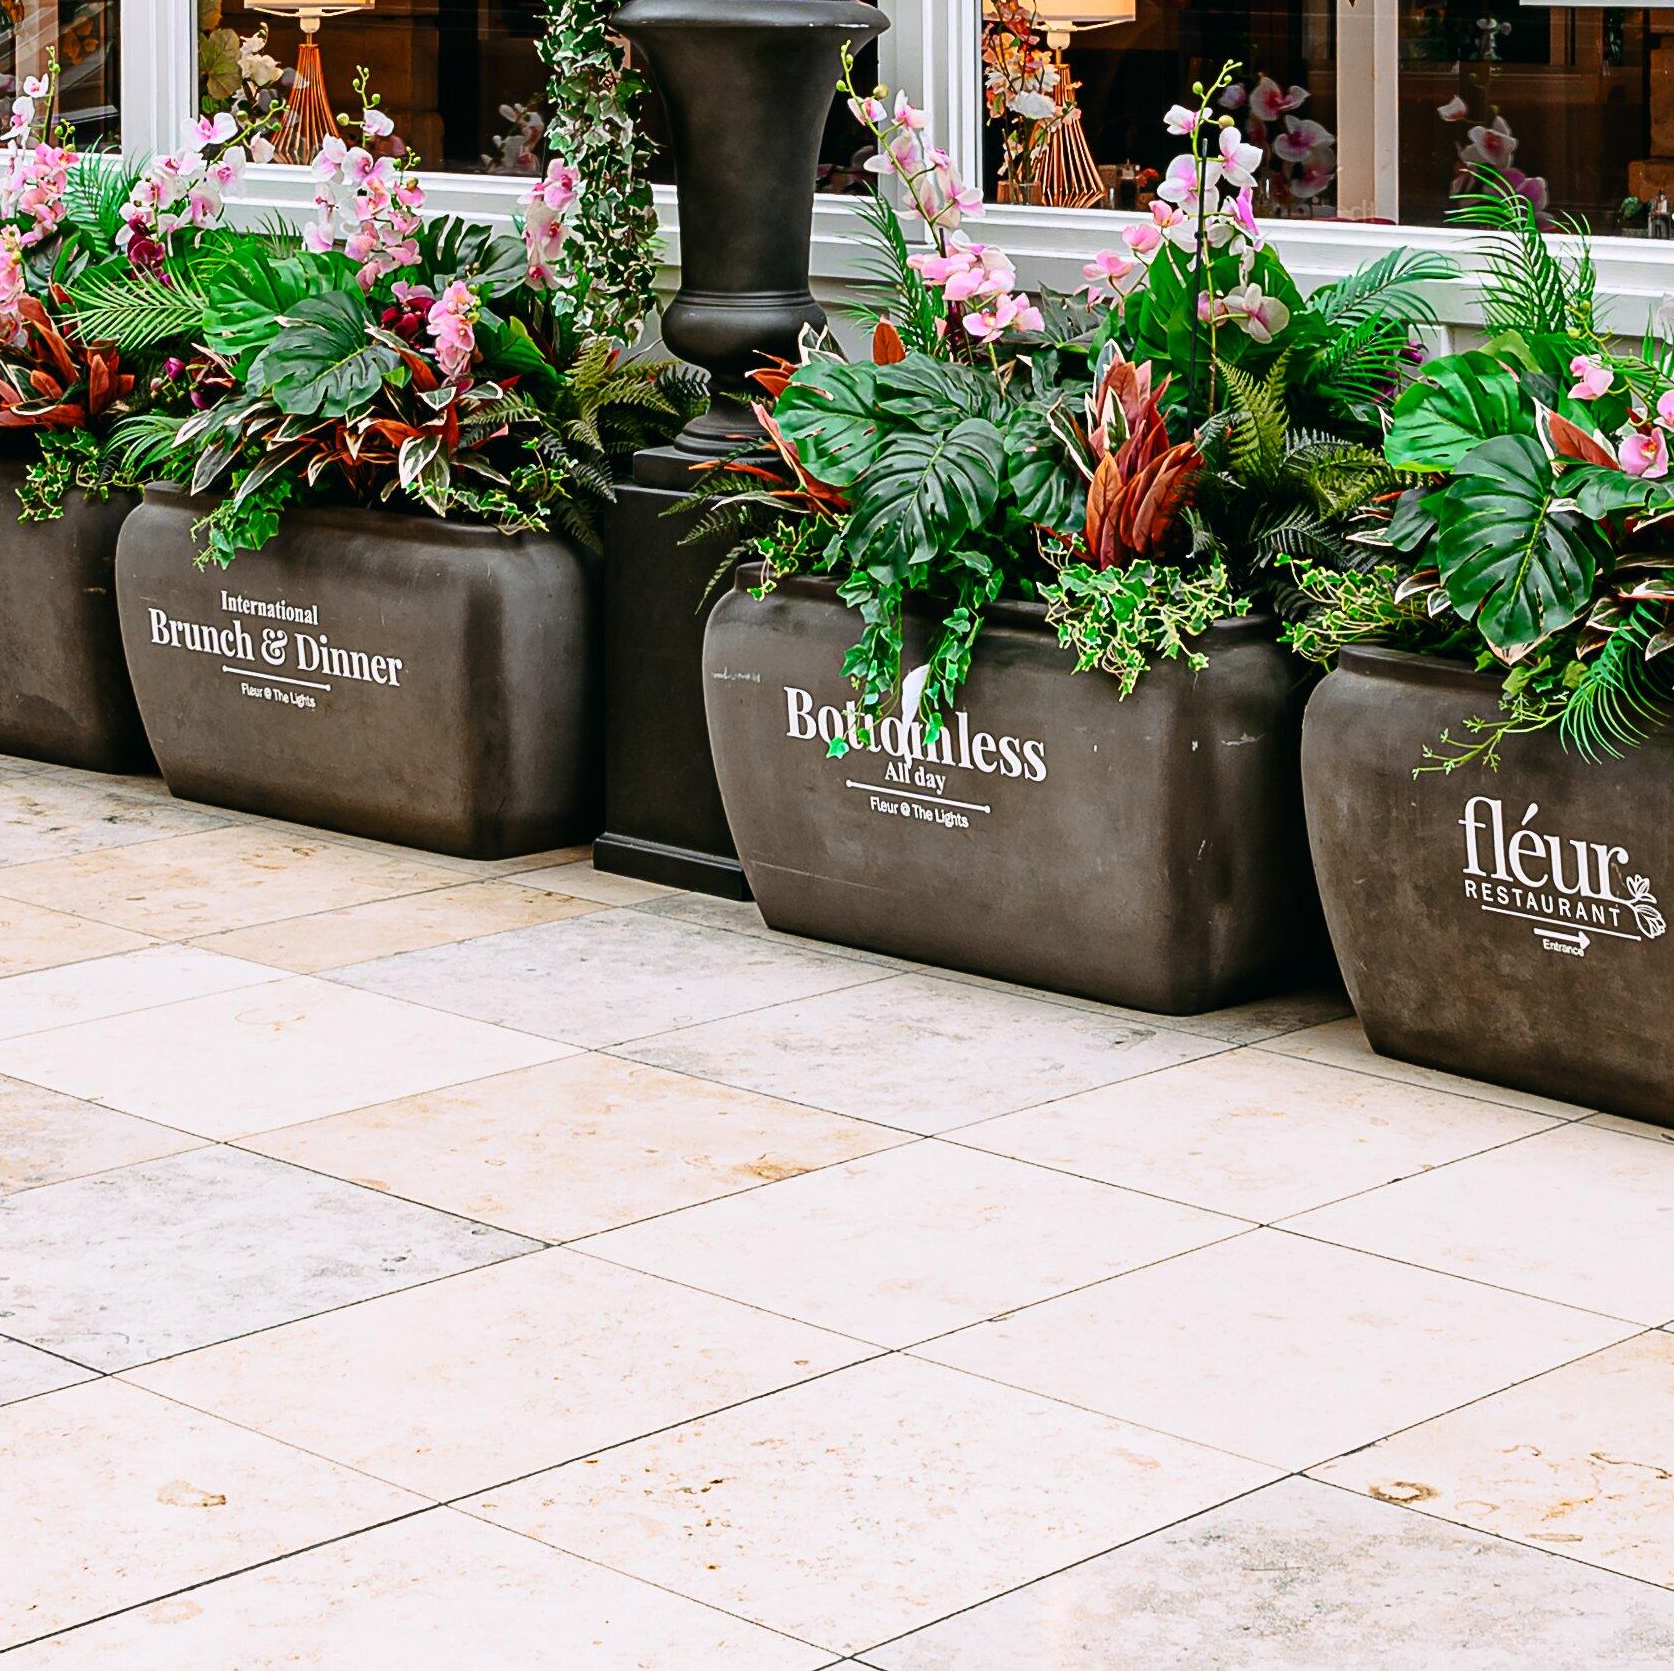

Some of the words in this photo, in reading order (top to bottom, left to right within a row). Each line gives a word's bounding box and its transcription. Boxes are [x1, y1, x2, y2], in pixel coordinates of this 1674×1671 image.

[220, 589, 319, 626] International
[147, 607, 256, 662] Brunch
[260, 627, 289, 666] &
[293, 632, 404, 687] Dinner
[884, 761, 911, 785] All
[913, 765, 947, 796] day
[869, 795, 899, 816] Fleur
[900, 801, 911, 818] @
[911, 803, 934, 823] The
[934, 808, 970, 829] Lights
[1457, 795, 1630, 904] fléur
[1464, 878, 1621, 928] RESTAURANT
[1542, 937, 1586, 958] Entrance
